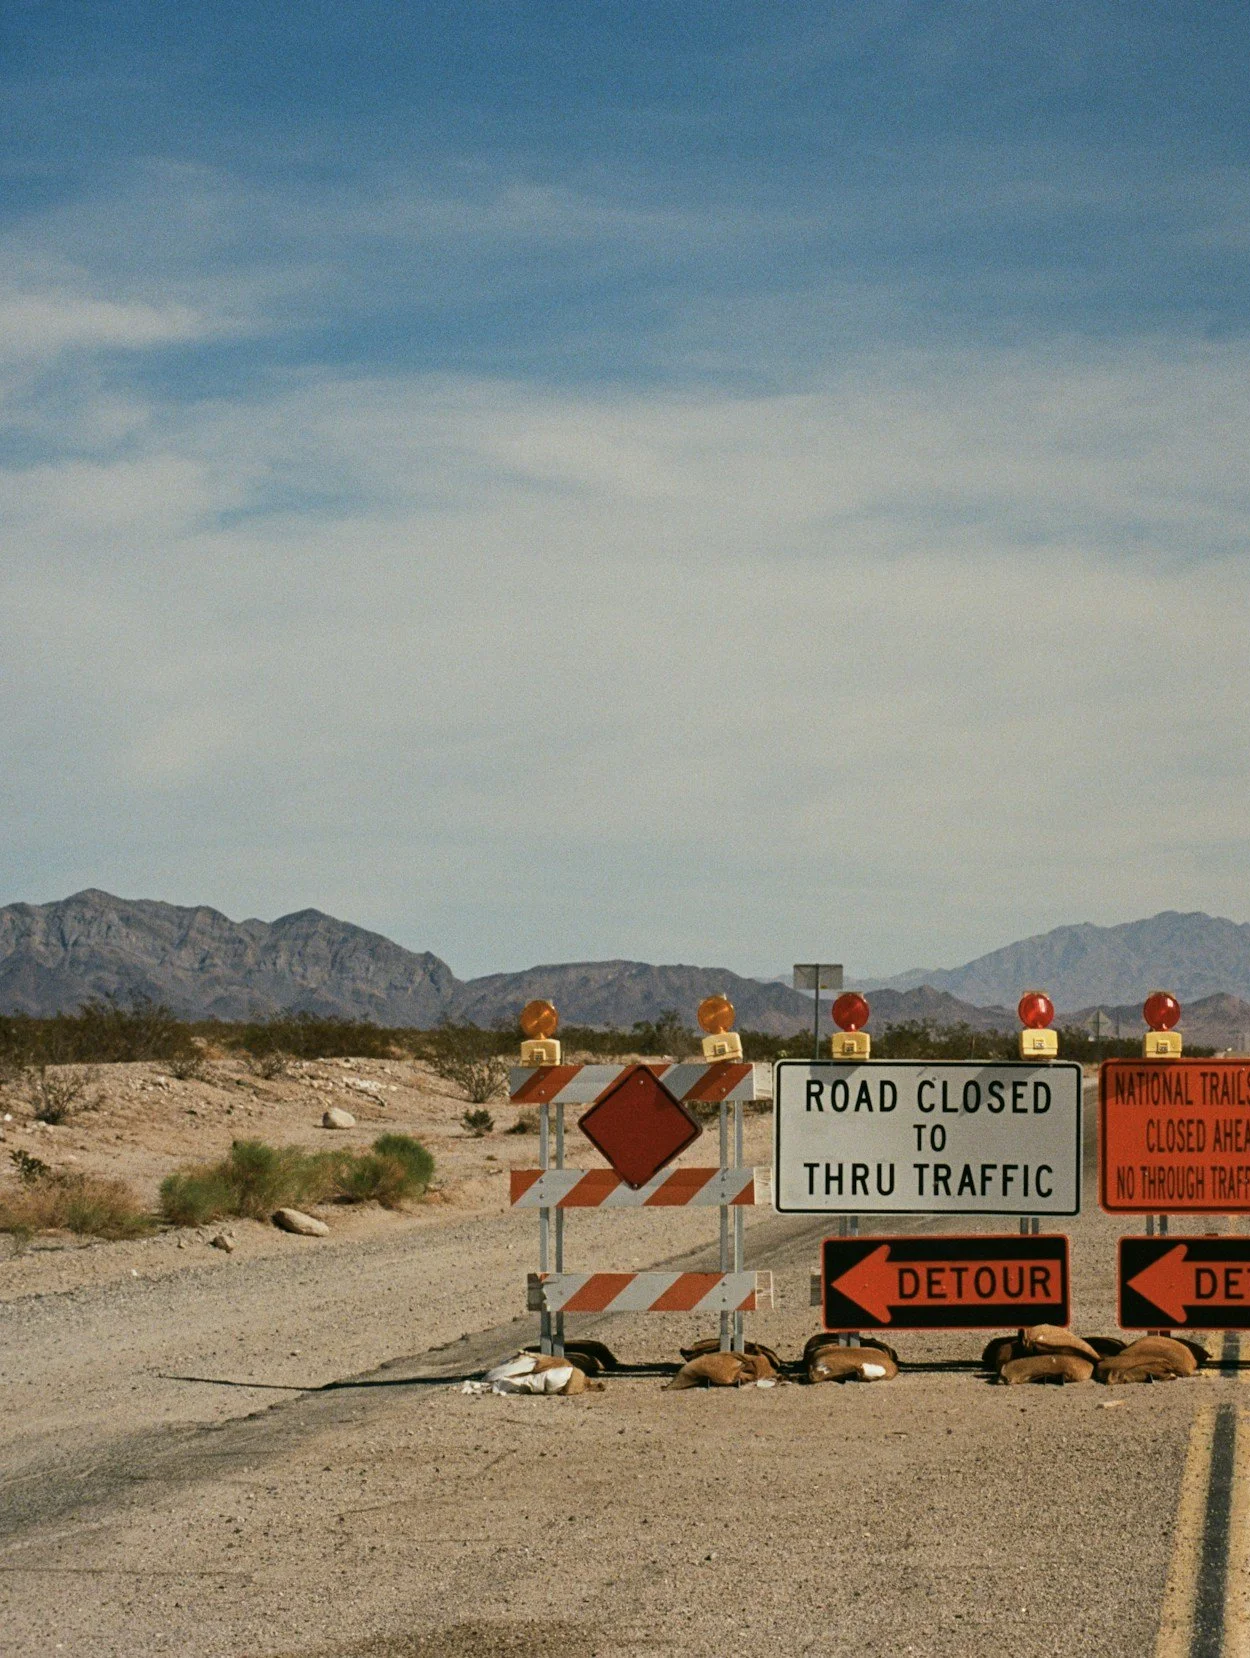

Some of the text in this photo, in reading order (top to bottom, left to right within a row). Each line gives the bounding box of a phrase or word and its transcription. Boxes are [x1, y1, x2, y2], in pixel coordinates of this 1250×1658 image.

[806, 1079, 1051, 1114] ROAD CLOSED
[1115, 1072, 1193, 1105] NATIONAL
[914, 1125, 946, 1152] TO
[1146, 1119, 1206, 1153] CLOSED
[804, 1163, 1053, 1198] THRU TRAFFIC
[1117, 1166, 1135, 1200] NO
[1141, 1166, 1204, 1200] THROUGH
[898, 1266, 1051, 1299] DETOUR
